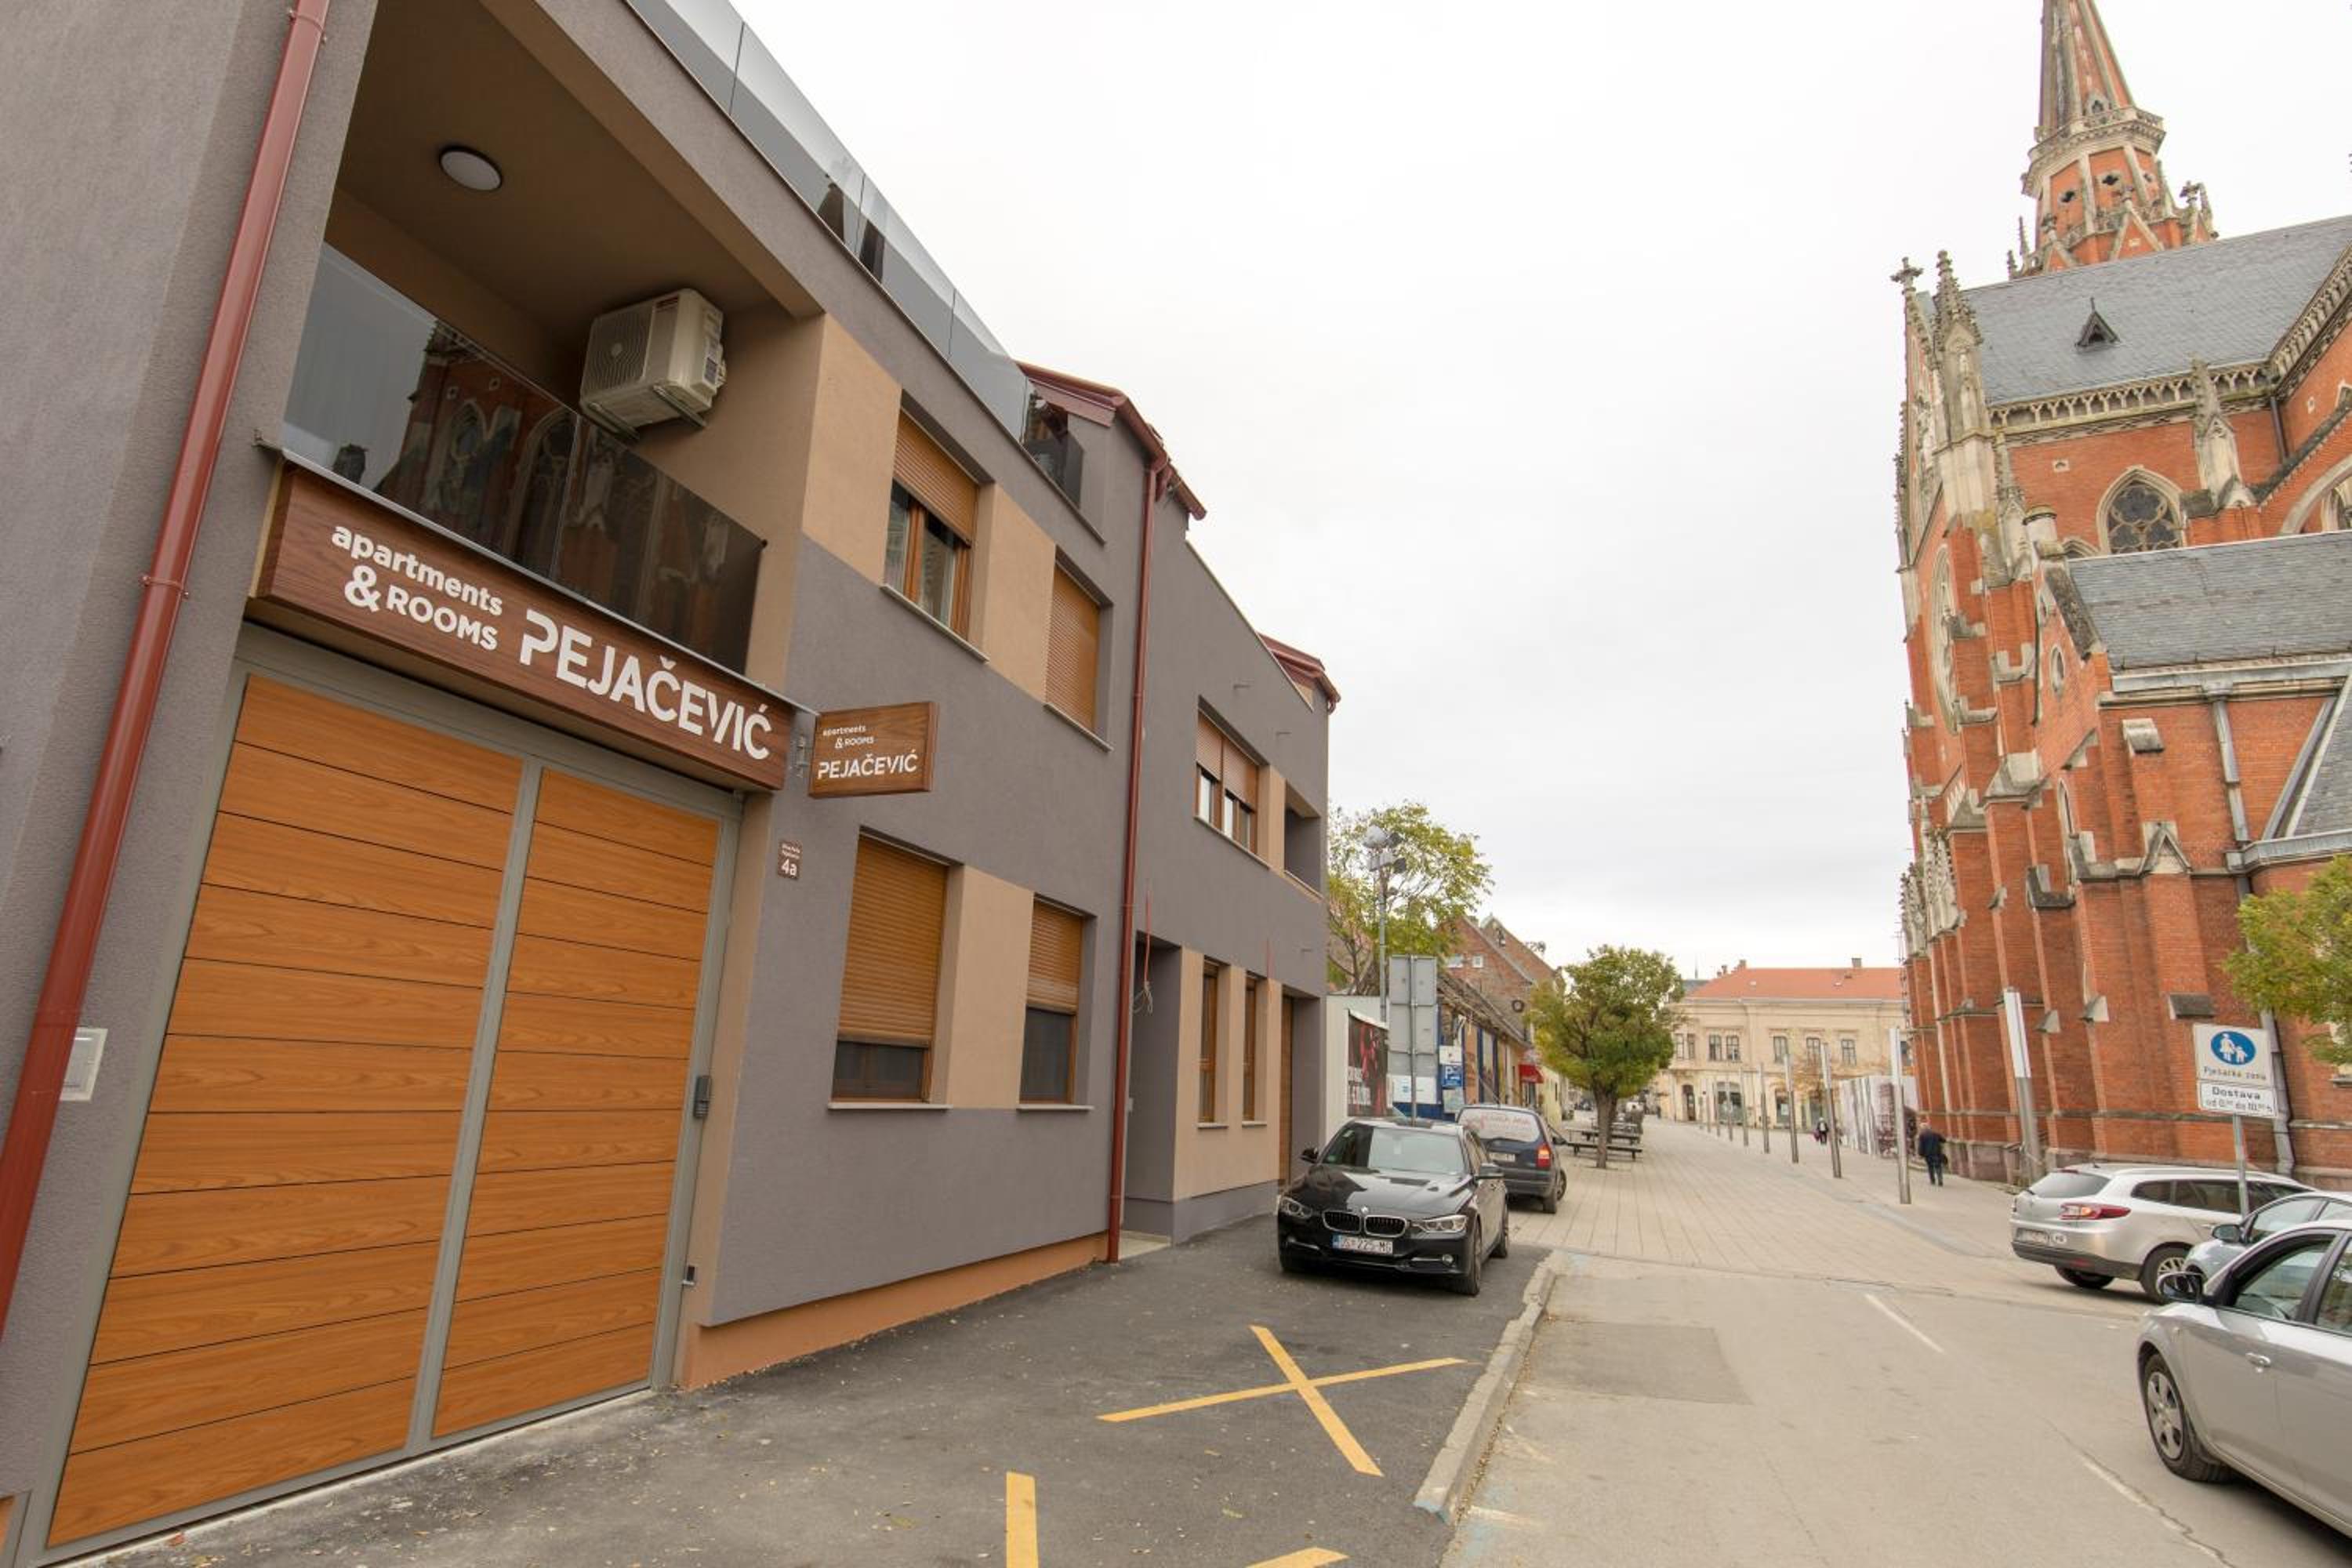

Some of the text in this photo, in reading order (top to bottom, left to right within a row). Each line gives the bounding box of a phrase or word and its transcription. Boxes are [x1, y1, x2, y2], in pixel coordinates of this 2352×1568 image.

[331, 526, 503, 616] apartments
[344, 565, 498, 650] & ROOMS
[520, 608, 772, 760] PEJAČEVIĆ
[822, 724, 866, 737] apartments
[834, 736, 874, 749] & ROOMS
[817, 749, 918, 779] PEJAČEVIĆ
[781, 858, 797, 876] 4a
[2212, 1086, 2260, 1100] Dostava
